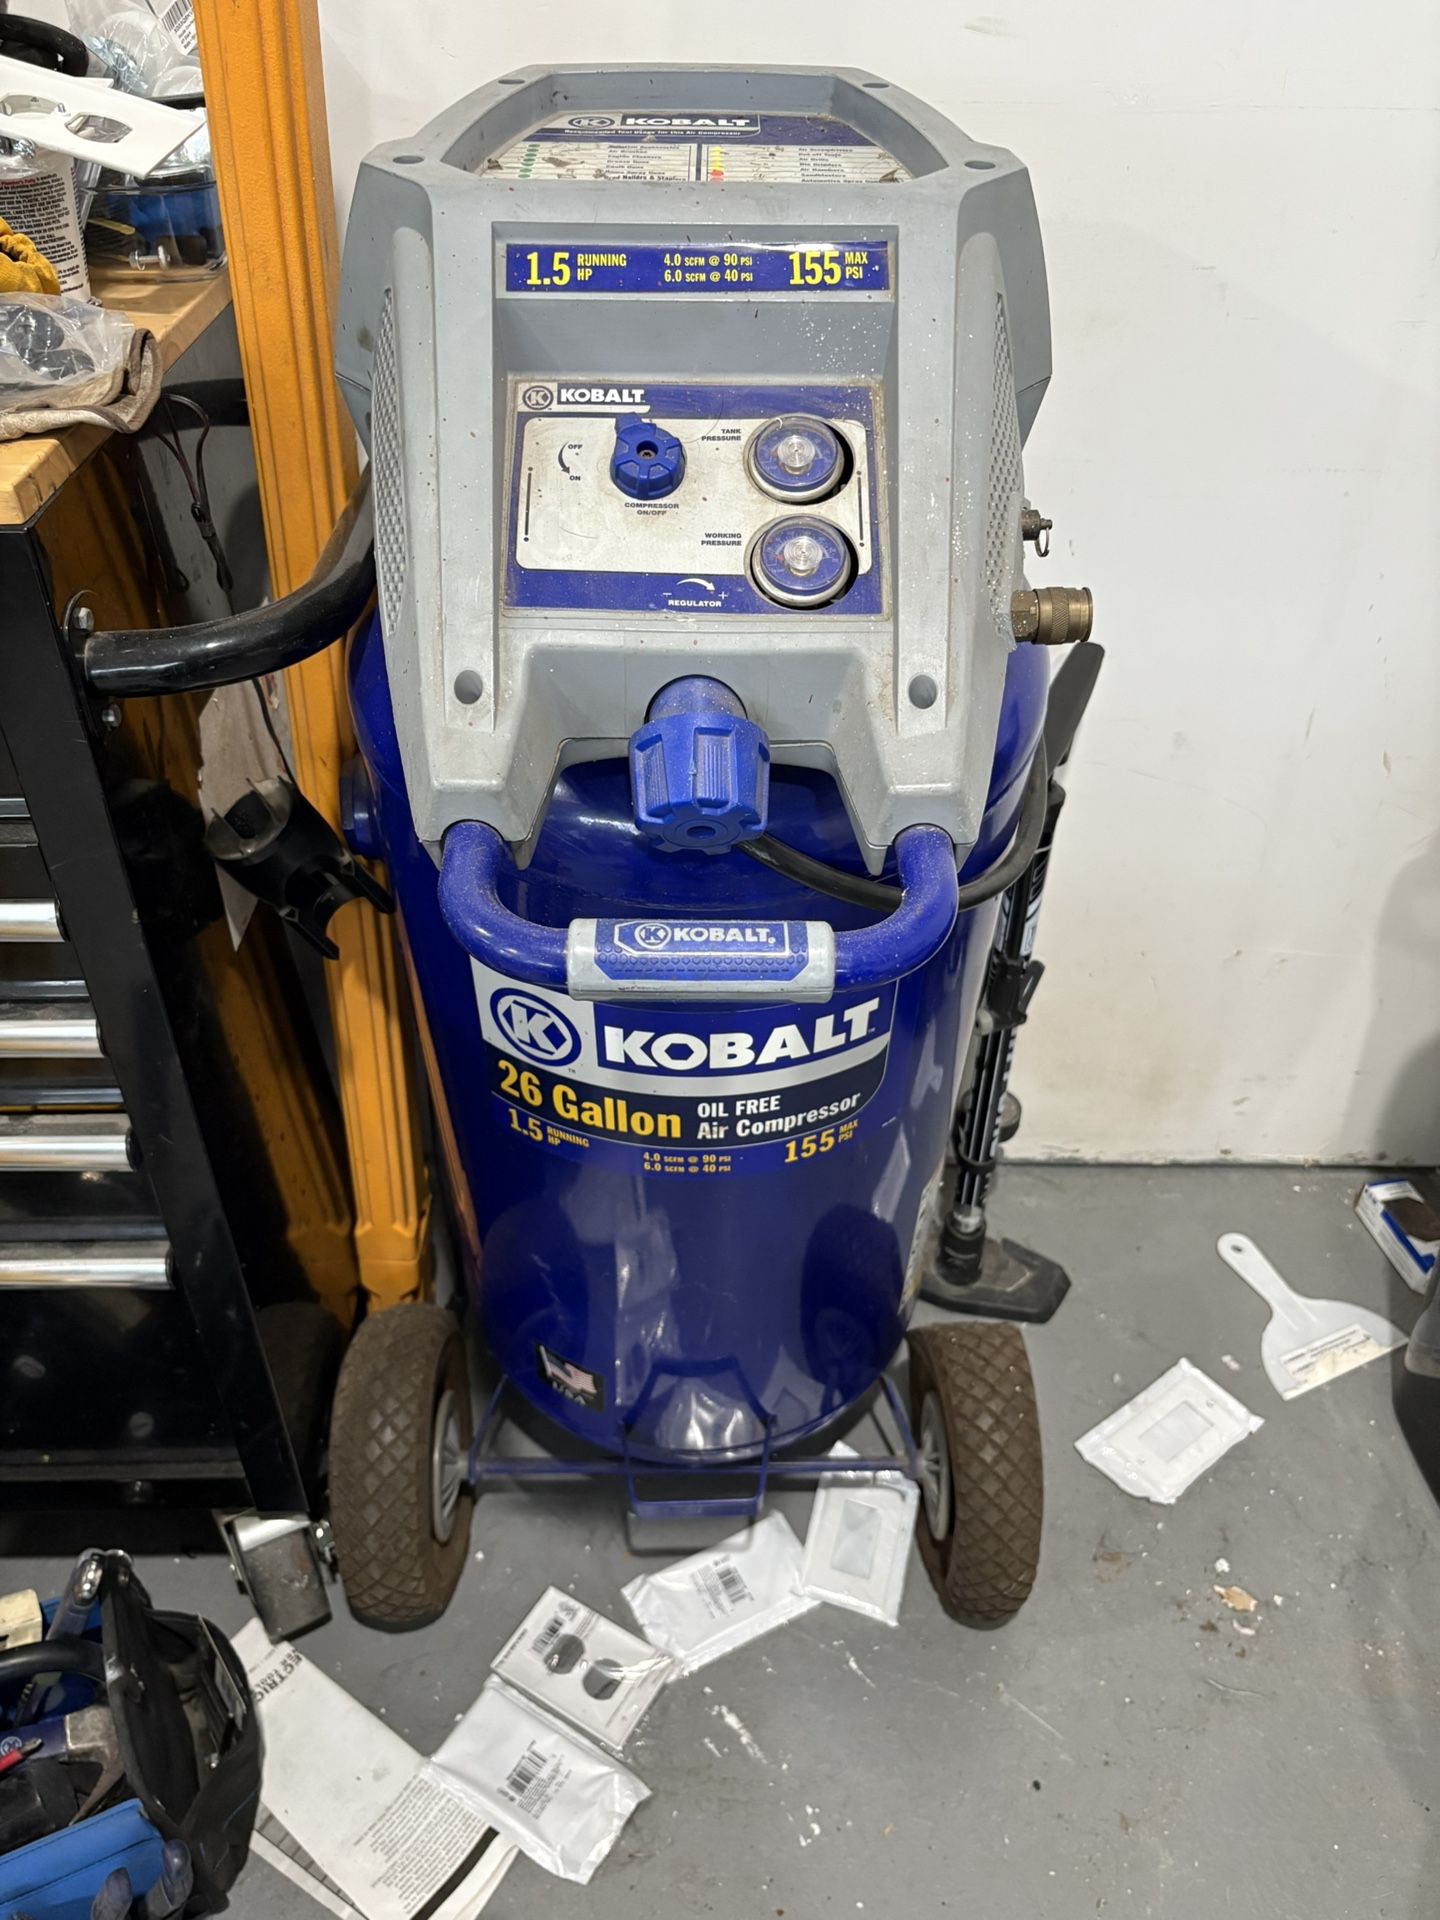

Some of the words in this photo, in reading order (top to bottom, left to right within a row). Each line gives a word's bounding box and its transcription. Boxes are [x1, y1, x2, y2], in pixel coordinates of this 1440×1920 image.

[625, 117, 750, 126] KOBALT
[526, 251, 571, 286] 1.5
[577, 254, 627, 267] RUNNING
[664, 255, 682, 266] 4.0
[684, 257, 705, 266] SCFM
[708, 255, 720, 266] @
[724, 255, 738, 266] 90
[740, 257, 753, 266] PSI
[789, 250, 841, 286] 155
[845, 252, 868, 266] MAX
[577, 268, 593, 281] HP
[664, 271, 682, 282] 6.0
[685, 273, 706, 282] SCFM
[709, 272, 721, 282] @
[724, 271, 738, 282] 40
[740, 273, 753, 282] PSI
[845, 267, 863, 280] PSI
[560, 388, 644, 403] KOBALT
[668, 599, 722, 607] REGULATOR
[673, 928, 769, 943] KOBALT
[604, 997, 880, 1071] KOBALT
[497, 1059, 544, 1108] 26
[552, 1084, 681, 1139] Gallon
[697, 1100, 729, 1119] OIL
[735, 1095, 781, 1115] FREE
[697, 1120, 729, 1140] Air
[735, 1093, 861, 1137] Compressor
[509, 1107, 544, 1143] 1.5
[546, 1127, 590, 1149] RUNNING
[838, 1118, 859, 1134] MAX
[547, 1137, 561, 1147] HP
[838, 1130, 853, 1143] PSI
[784, 1128, 836, 1163] 155
[643, 1152, 661, 1162] 4.0
[664, 1155, 684, 1163] SCFM
[702, 1154, 716, 1163] 90
[719, 1155, 732, 1163] PSI
[643, 1163, 661, 1172] 6.0
[664, 1165, 685, 1173] SCFM
[702, 1164, 717, 1173] 40
[718, 1165, 731, 1173] PSI
